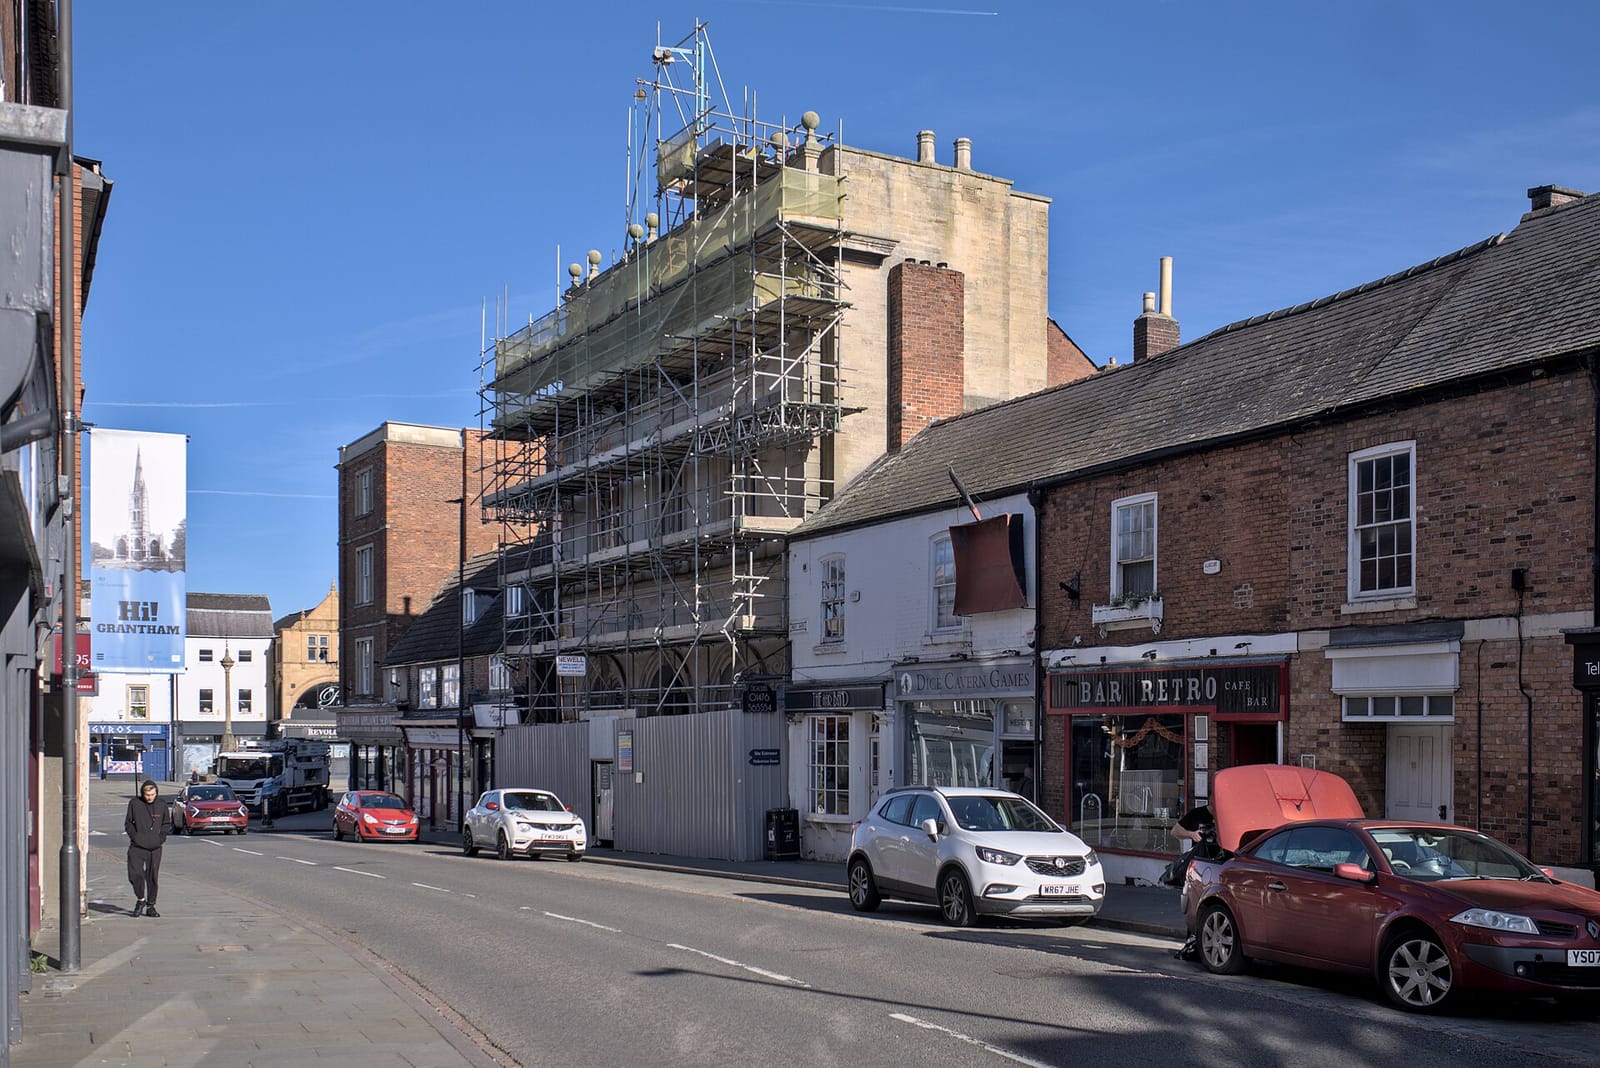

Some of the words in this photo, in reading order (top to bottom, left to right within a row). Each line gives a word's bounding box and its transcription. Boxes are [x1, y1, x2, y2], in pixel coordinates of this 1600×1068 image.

[119, 601, 158, 621] Hi!
[97, 623, 180, 635] GRANTHAM
[916, 674, 942, 690] DICE
[944, 672, 986, 689] CAVERN
[989, 670, 1030, 688] GAMES
[1080, 681, 1122, 702] BAR
[1140, 677, 1217, 702] RETRO
[1247, 697, 1268, 706] BAR
[91, 725, 132, 734] GYROS
[1044, 886, 1064, 894] WR67
[1065, 885, 1079, 894] JHE
